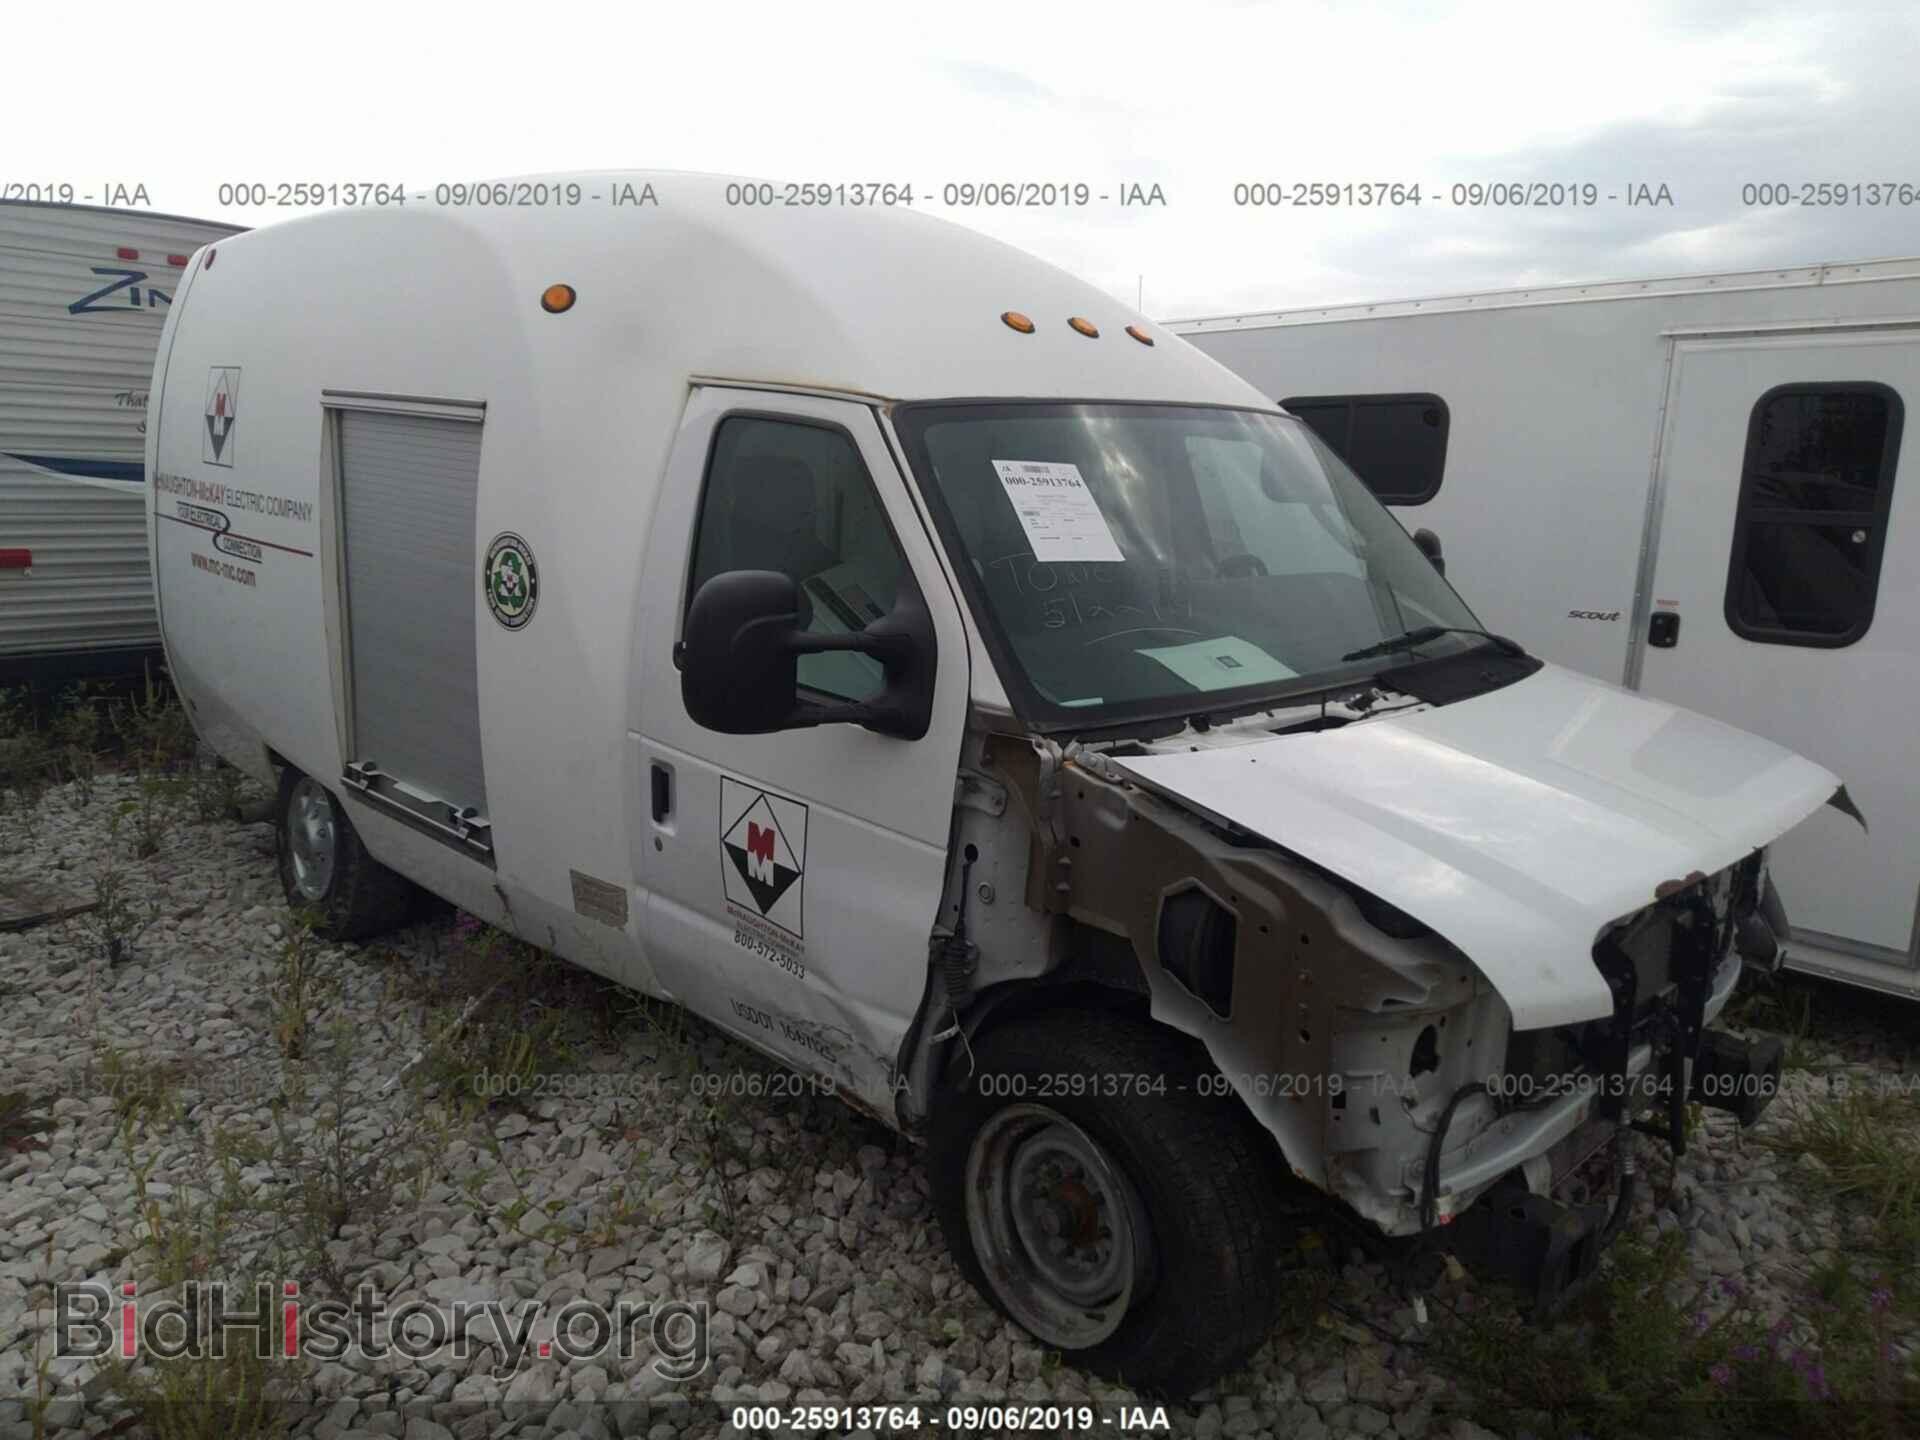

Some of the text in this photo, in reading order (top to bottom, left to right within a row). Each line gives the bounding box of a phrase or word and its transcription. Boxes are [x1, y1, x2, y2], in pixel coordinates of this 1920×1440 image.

[1005, 476, 1082, 488] 000-25913764
[226, 487, 265, 514] ELECTRIC
[267, 493, 313, 523] COMPANY
